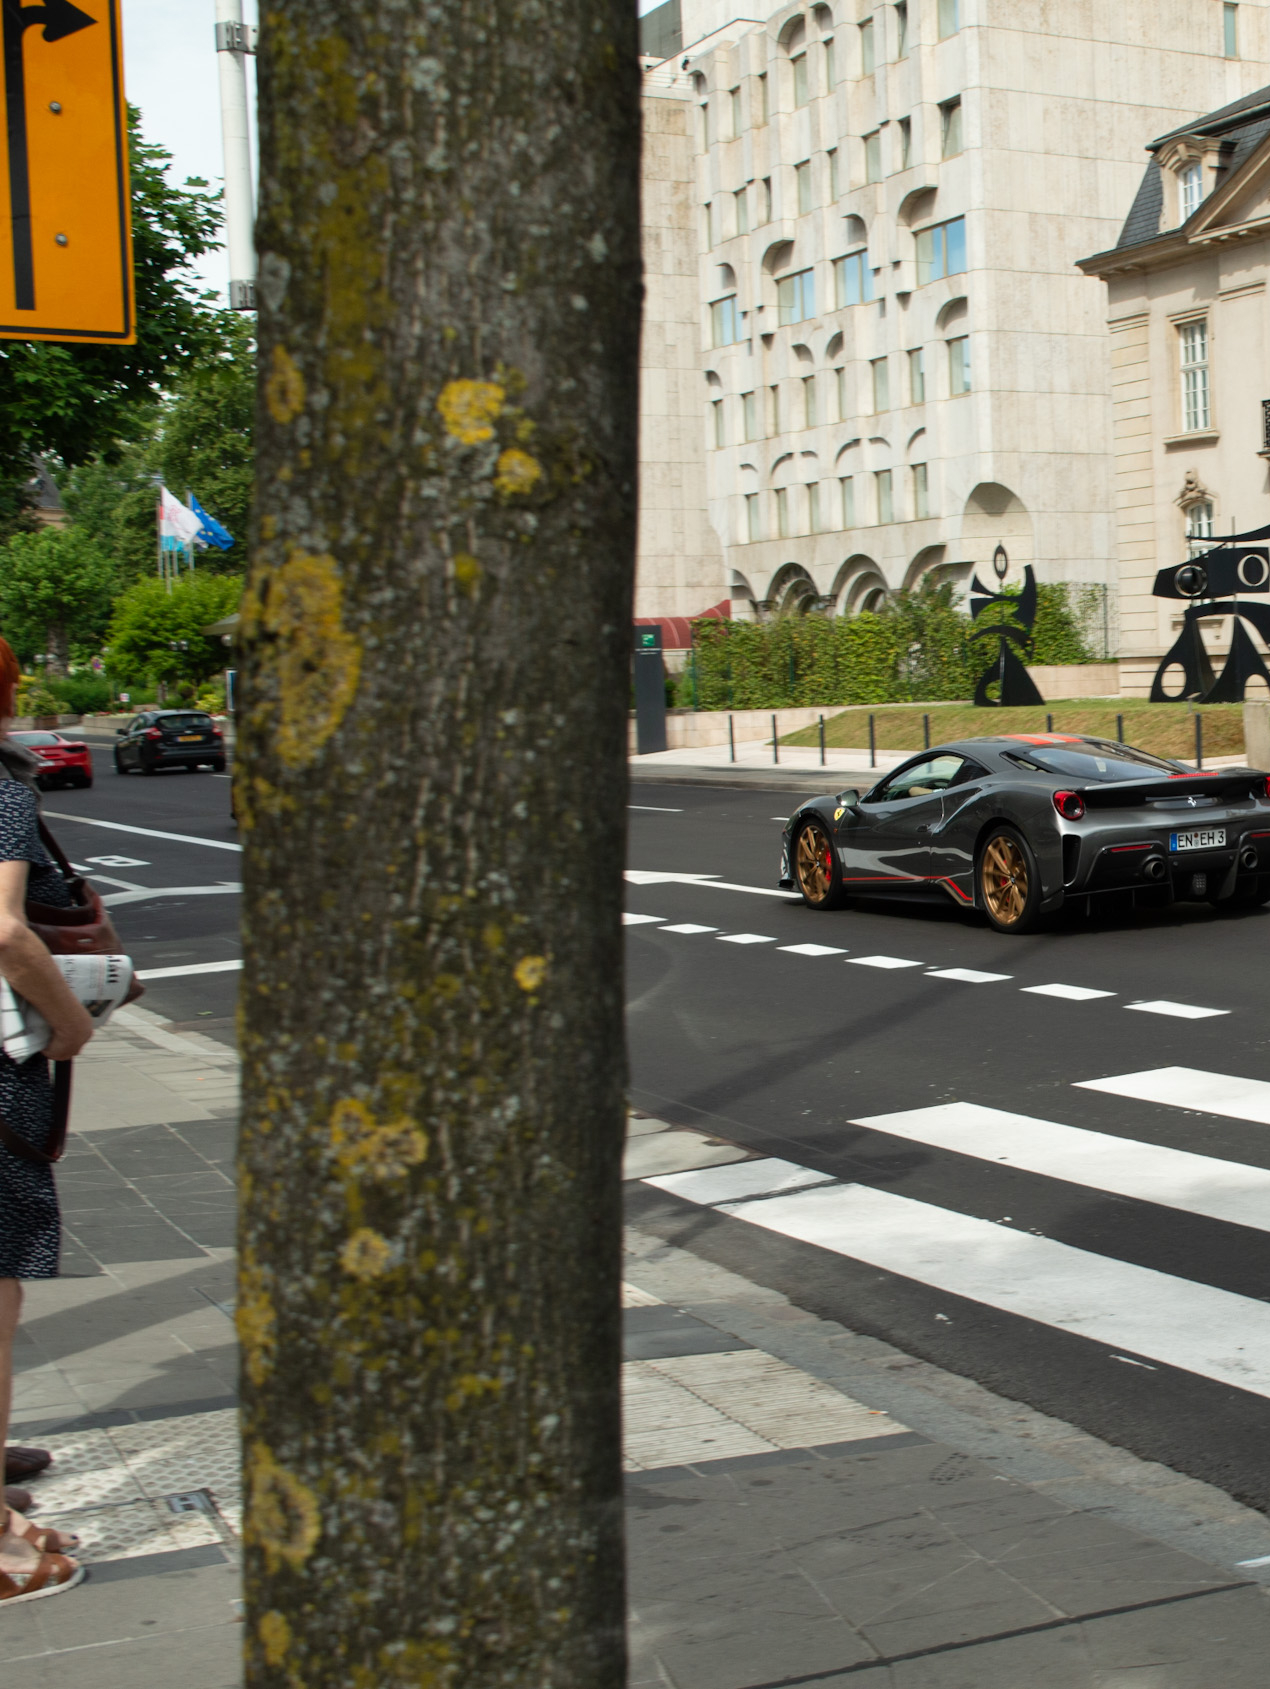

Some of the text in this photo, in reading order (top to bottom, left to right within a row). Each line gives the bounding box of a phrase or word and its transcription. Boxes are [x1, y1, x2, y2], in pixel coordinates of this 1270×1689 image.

[1178, 830, 1225, 848] EN EH 3
